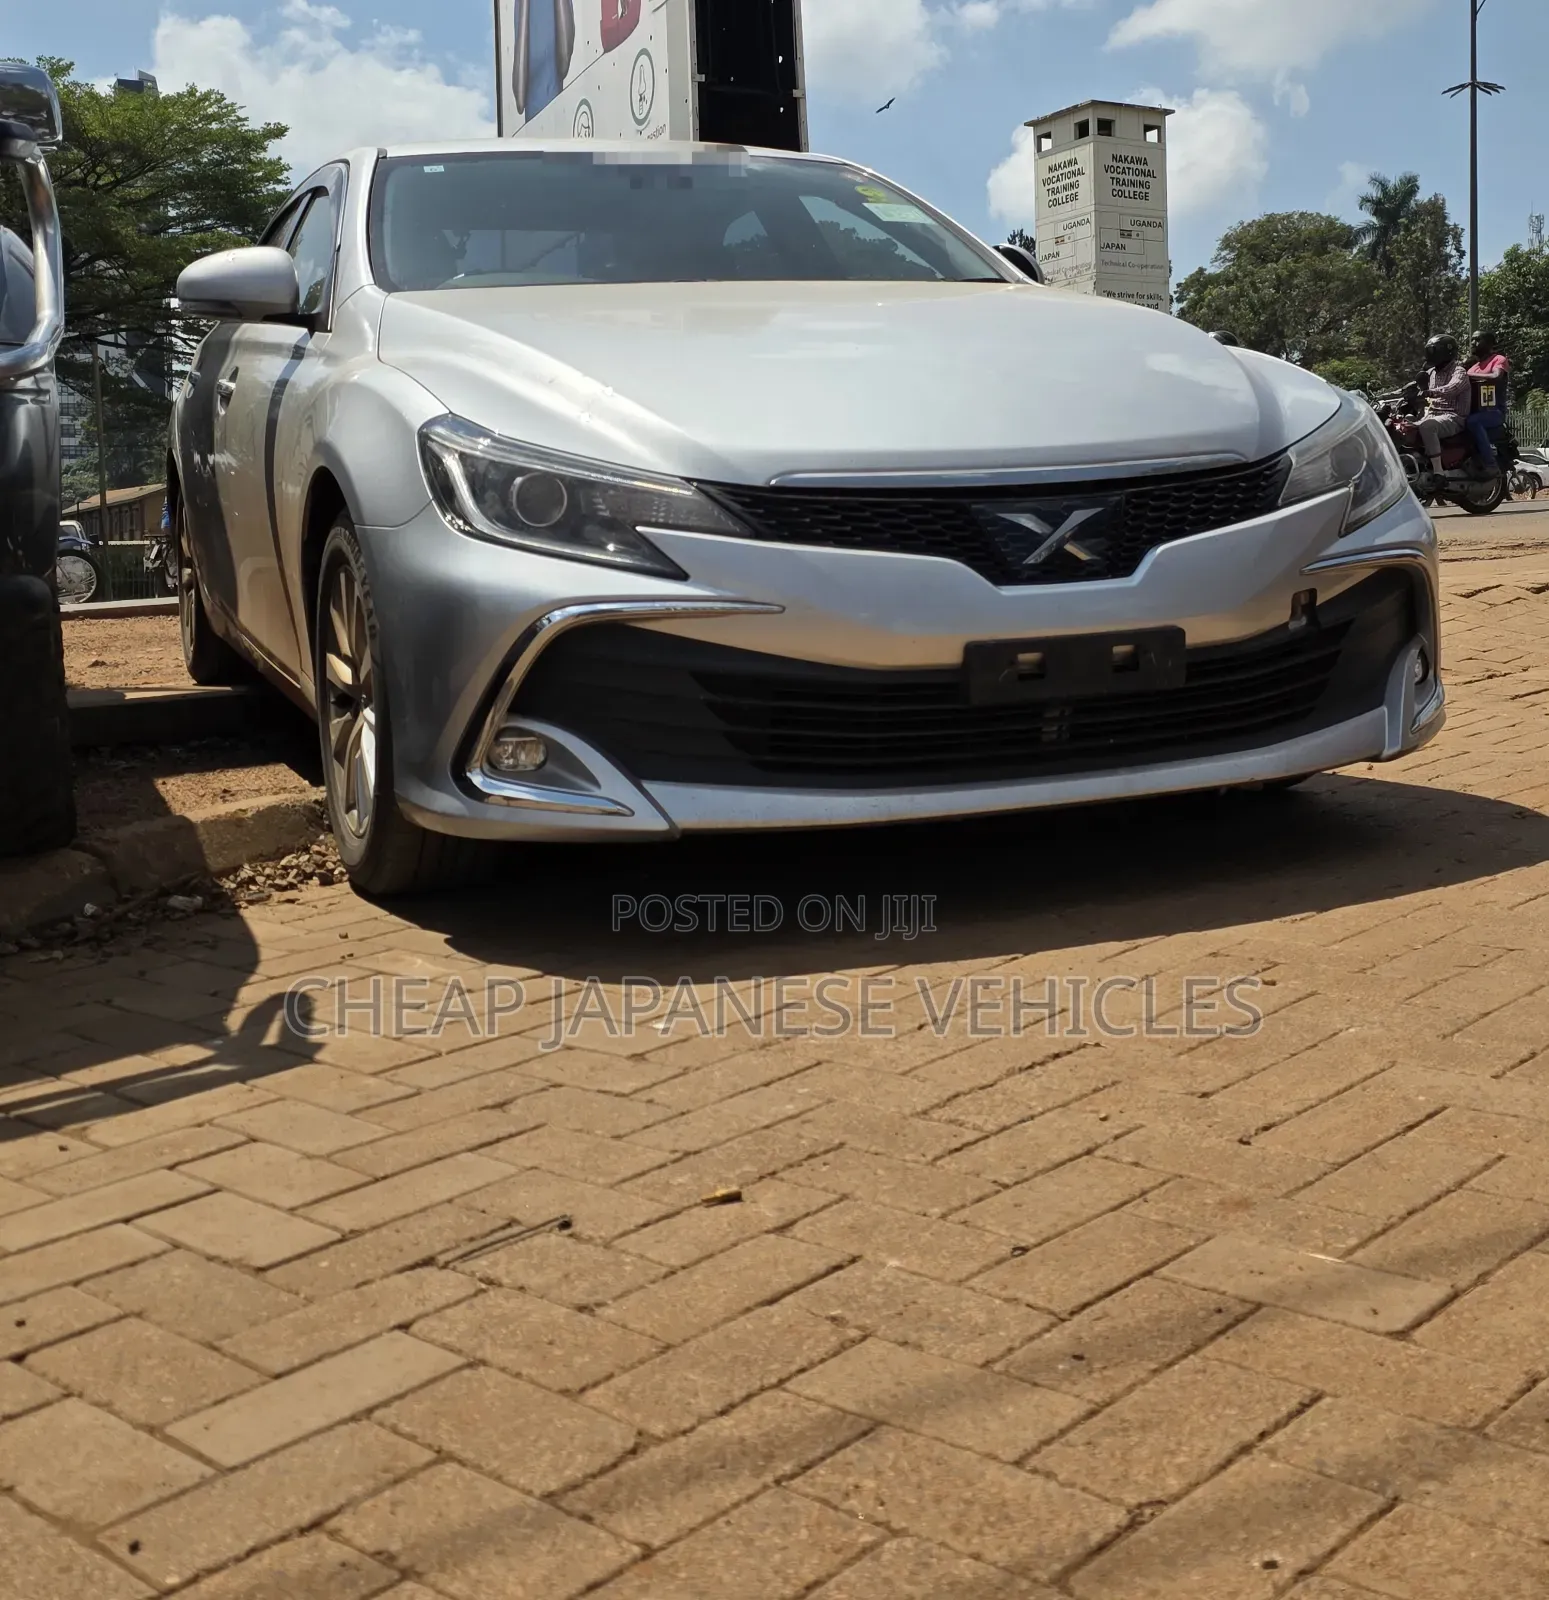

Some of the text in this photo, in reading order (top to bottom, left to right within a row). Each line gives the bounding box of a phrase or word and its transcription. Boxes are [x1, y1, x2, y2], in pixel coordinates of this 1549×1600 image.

[1048, 157, 1079, 174] NAKAWA
[1111, 153, 1149, 167] NAKAWA
[1042, 166, 1086, 187] VOCATIONAL
[1103, 164, 1157, 179] VOCATIONAL
[1046, 179, 1080, 198] TRAINING
[1110, 176, 1151, 190] TRAINING
[1047, 191, 1079, 208] COLLEGE
[1111, 188, 1150, 201] COLLEGE
[1062, 217, 1091, 231] UGANDA
[1129, 219, 1163, 229] UGANDA
[1100, 242, 1127, 251] JAPAN
[1040, 250, 1060, 263] JAPAN
[1117, 291, 1135, 299] strive
[1136, 291, 1146, 299] for
[1146, 292, 1164, 302] skills,
